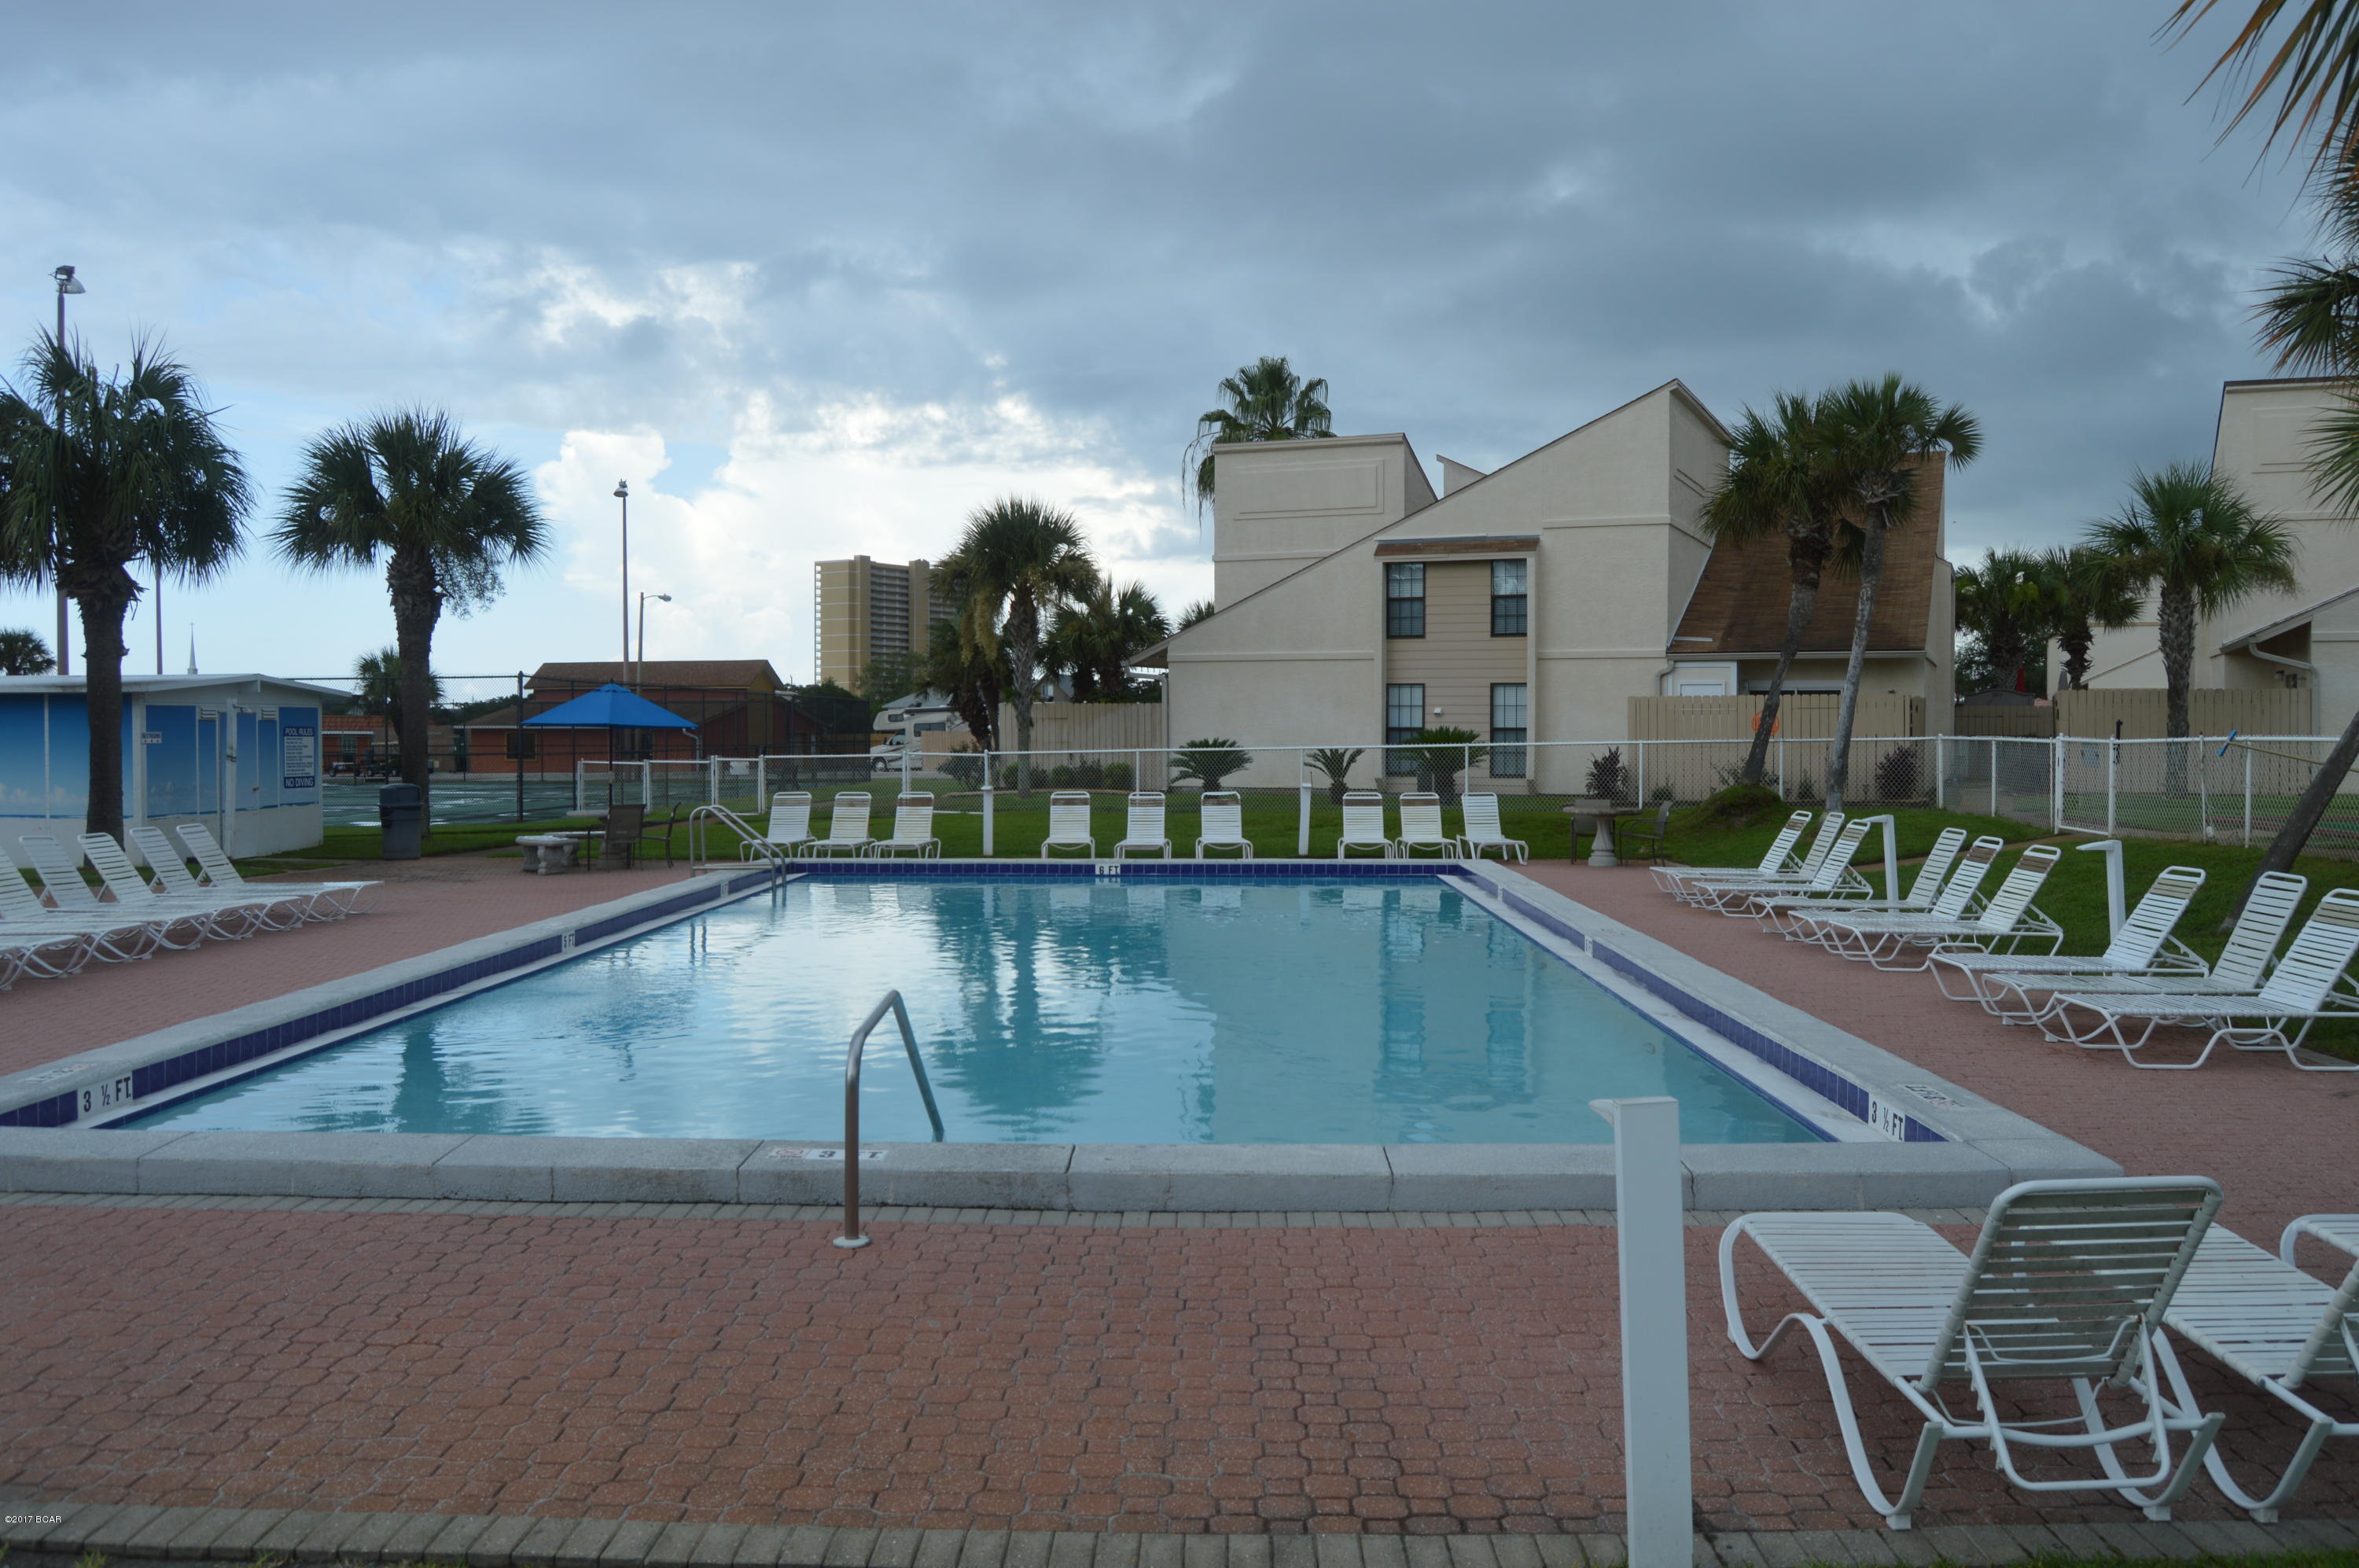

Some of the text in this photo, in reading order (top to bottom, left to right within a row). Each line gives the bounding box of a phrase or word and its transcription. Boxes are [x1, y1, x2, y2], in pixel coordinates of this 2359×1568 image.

[285, 777, 314, 786] NO DIVING
[1099, 866, 1105, 874] 6
[83, 1091, 91, 1113] 3
[1871, 1101, 1878, 1124] 3
